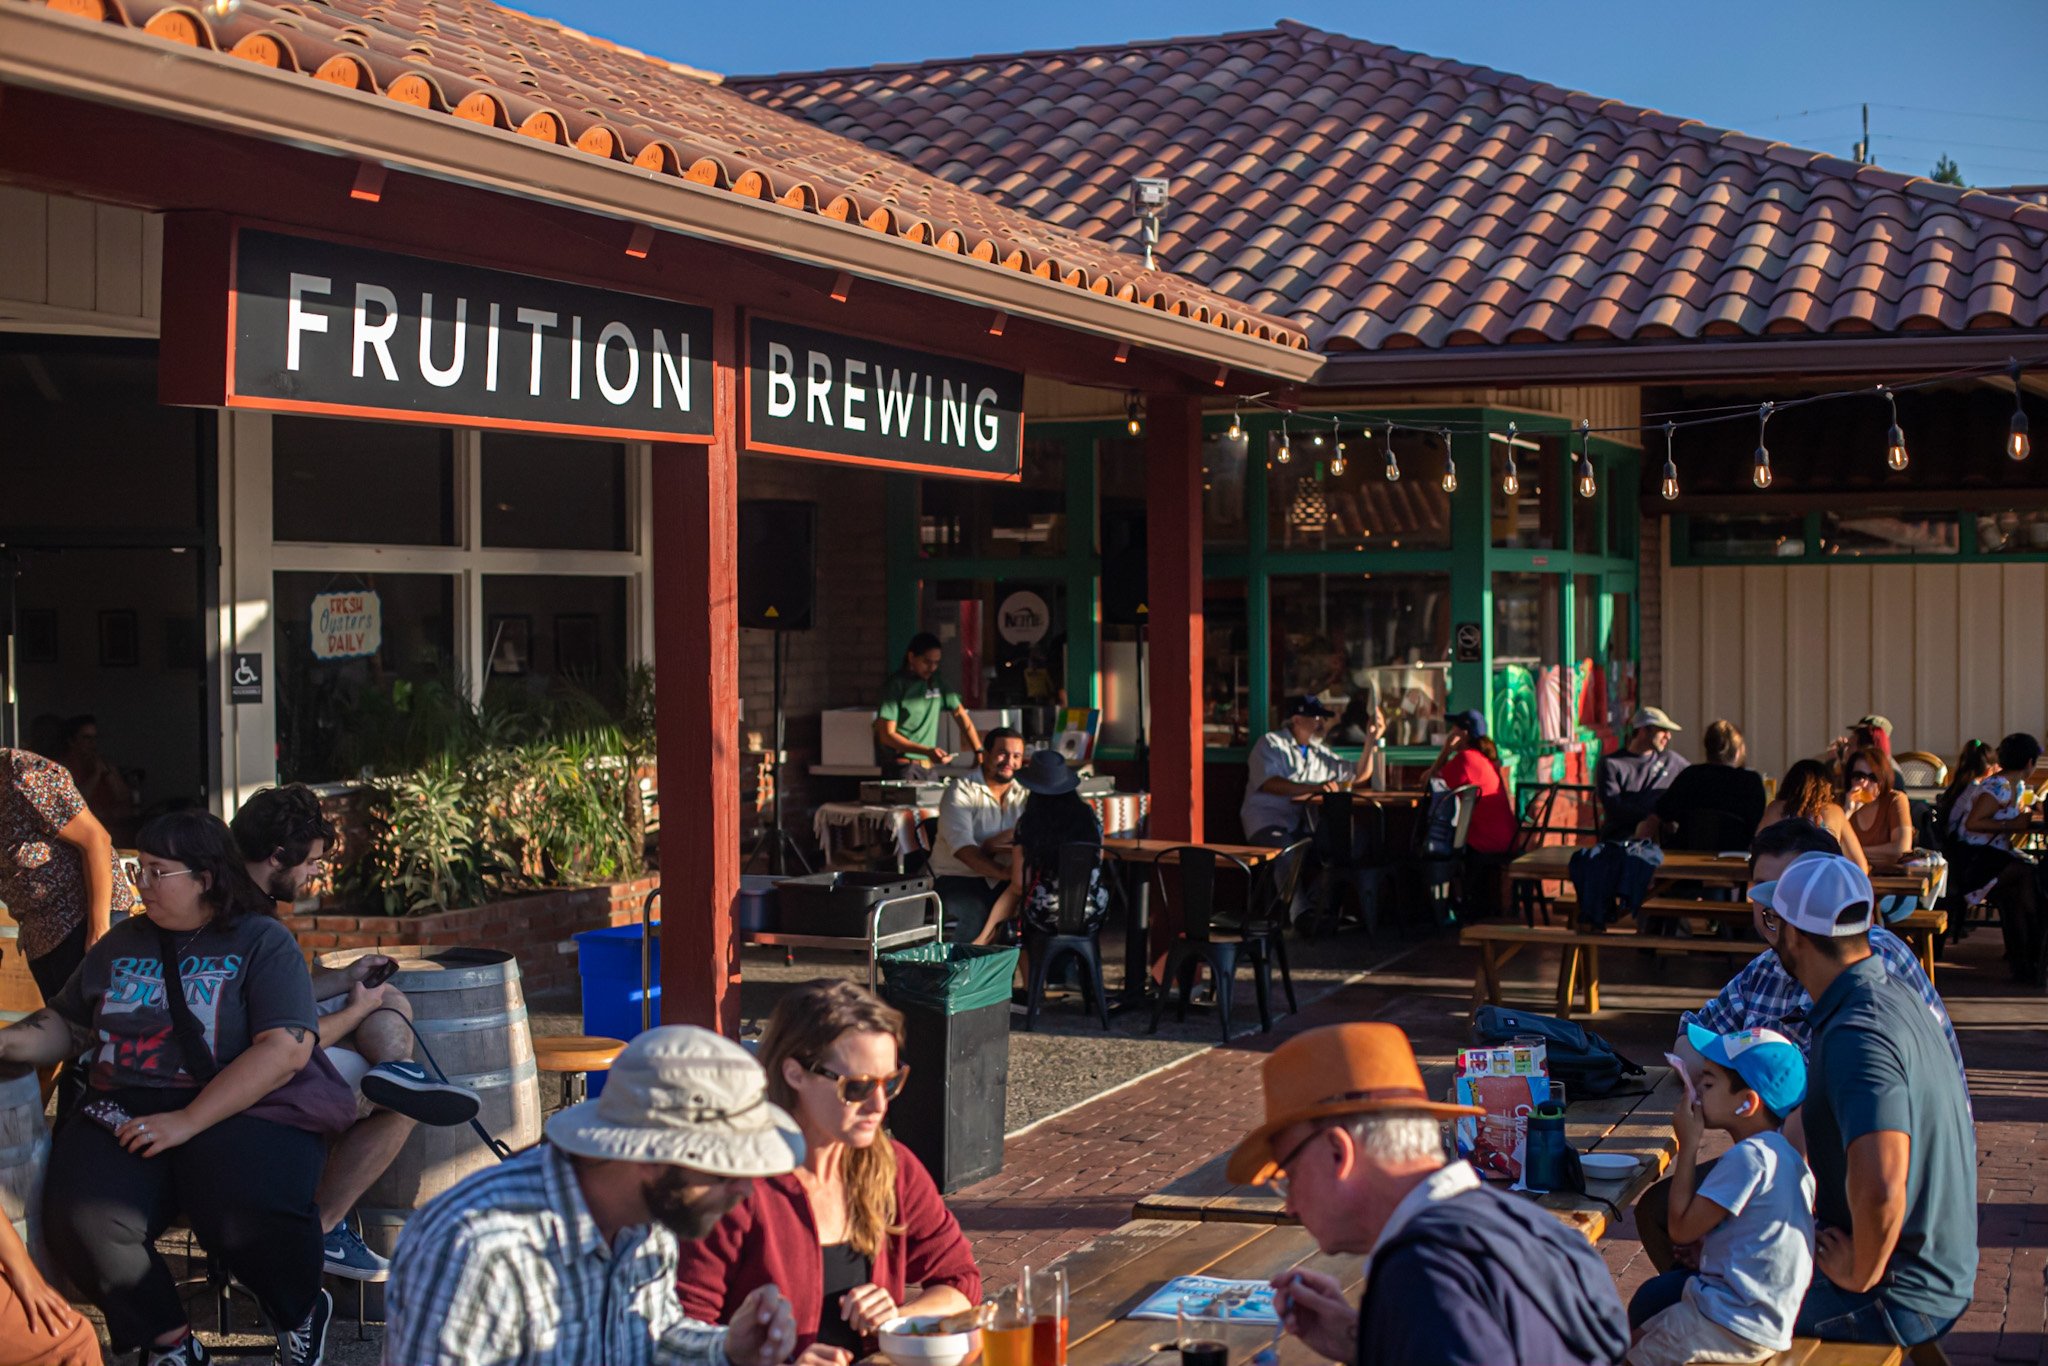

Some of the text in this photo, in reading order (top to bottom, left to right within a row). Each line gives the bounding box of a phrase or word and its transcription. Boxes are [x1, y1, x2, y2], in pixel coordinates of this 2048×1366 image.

[286, 272, 691, 412] FRUITION
[767, 341, 999, 452] BREWING
[329, 596, 364, 614] FRESH
[320, 608, 373, 634] Oysters
[328, 631, 365, 654] DAILY
[111, 976, 221, 1007] DUN
